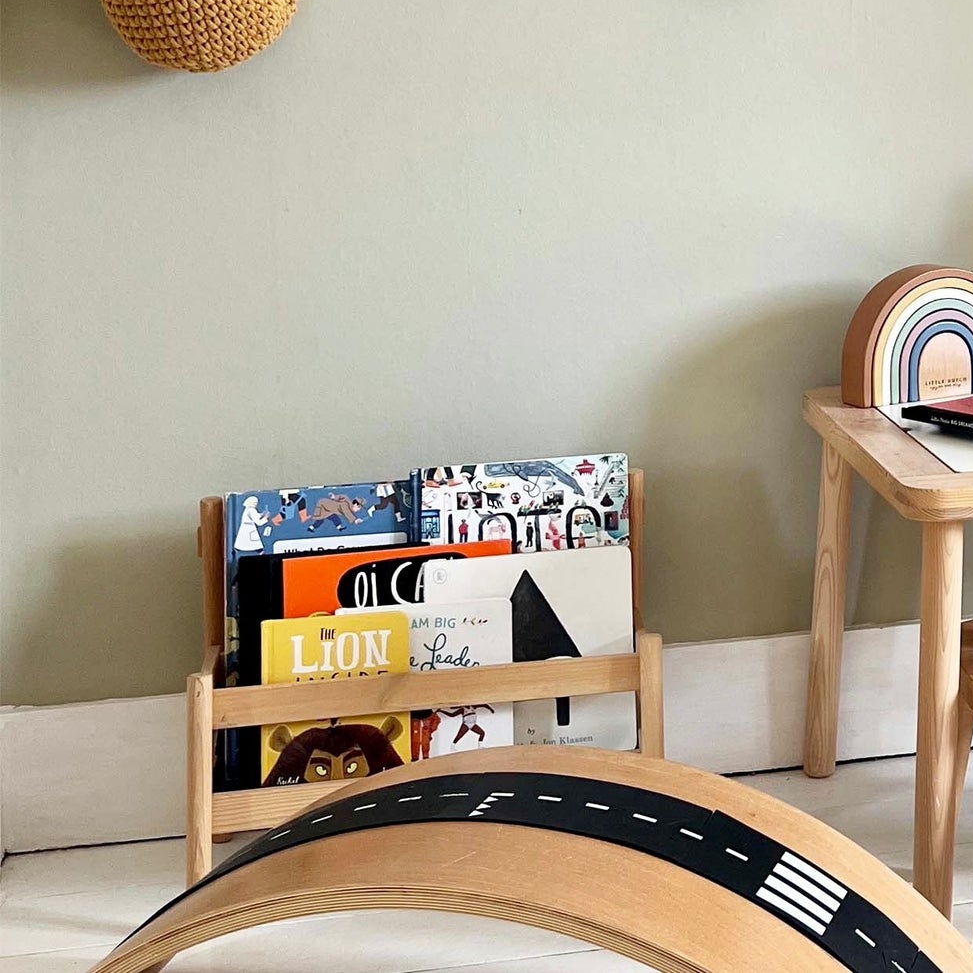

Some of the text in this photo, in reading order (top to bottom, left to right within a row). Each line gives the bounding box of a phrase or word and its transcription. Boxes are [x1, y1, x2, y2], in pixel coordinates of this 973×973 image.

[434, 617, 456, 629] BIG
[320, 628, 336, 640] THE
[290, 629, 391, 674] LION
